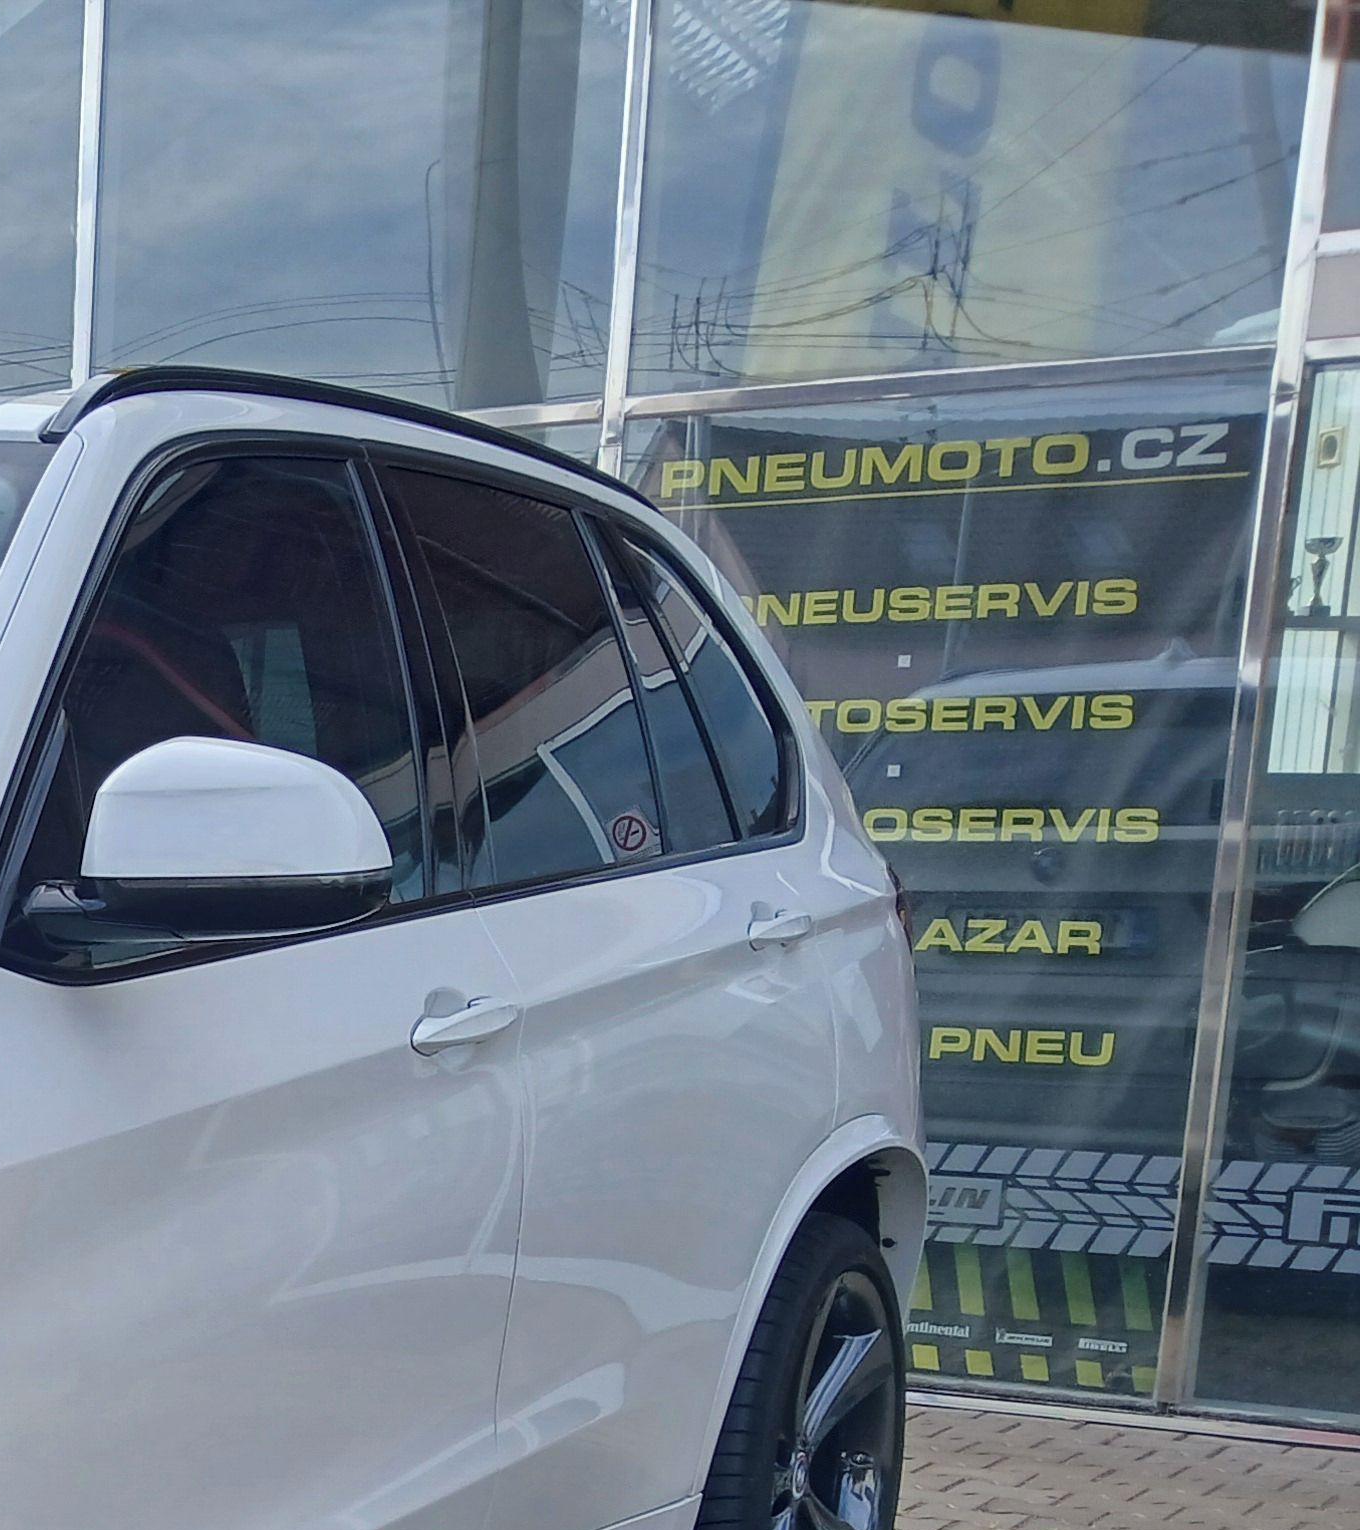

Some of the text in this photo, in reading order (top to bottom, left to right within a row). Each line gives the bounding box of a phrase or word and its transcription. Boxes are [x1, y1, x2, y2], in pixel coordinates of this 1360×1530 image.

[660, 422, 1230, 499] PNEUMOTO.CZ
[914, 918, 1103, 954] AZAR
[928, 1027, 1116, 1067] PNEU
